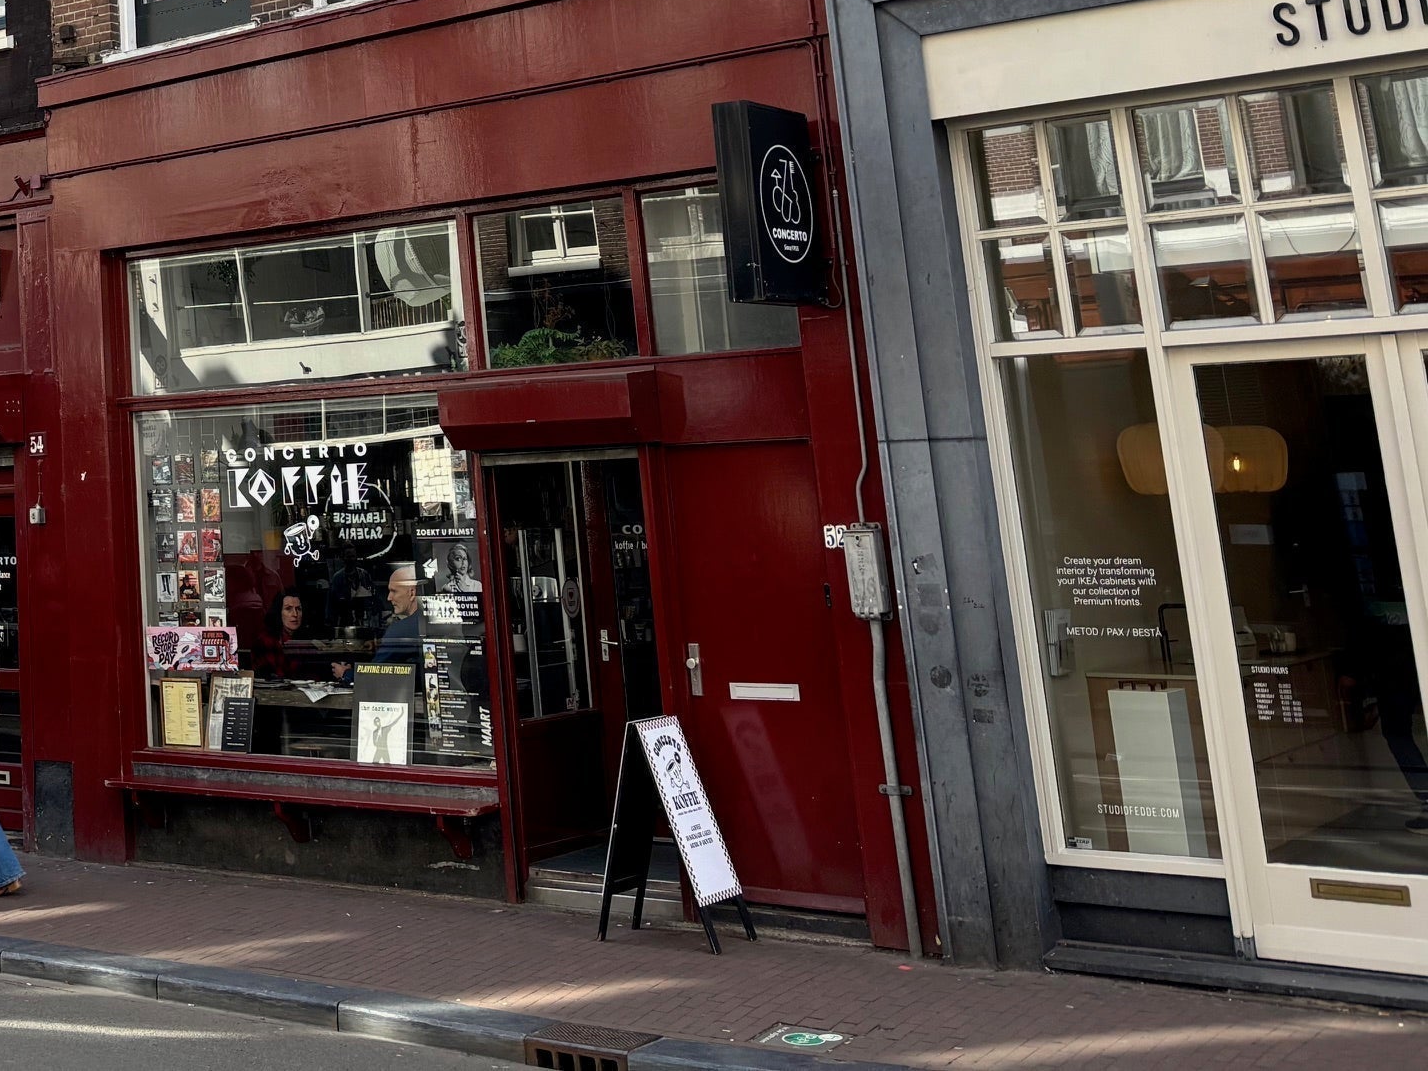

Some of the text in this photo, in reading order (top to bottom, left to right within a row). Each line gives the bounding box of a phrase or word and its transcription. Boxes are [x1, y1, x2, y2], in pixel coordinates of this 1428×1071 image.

[772, 227, 808, 242] CONCERTO
[30, 435, 44, 454] 54
[225, 441, 368, 463] CONCERTO
[226, 463, 368, 508] KOFFIE
[448, 528, 474, 536] FILMS?
[825, 527, 846, 547] 52
[614, 540, 634, 550] koffie
[1063, 556, 1142, 567] Create your dream
[1056, 567, 1155, 577] interior by transforming
[1057, 577, 1157, 586] your IKEA cabinets with
[1088, 587, 1130, 596] collection
[1131, 586, 1141, 596] of
[1073, 597, 1143, 606] Premium fronts.
[1066, 626, 1099, 636] METOD
[1106, 627, 1125, 636] PAX
[152, 631, 180, 648] RECORD
[154, 642, 178, 655] STORE
[158, 652, 176, 665] DAY
[357, 665, 412, 675] PLAYING LIVE TODAY
[1251, 665, 1289, 675] STUDIO HOURS
[479, 706, 492, 746] MAART
[653, 734, 682, 757] CONCERTO
[672, 790, 701, 810] KOFFIE
[1097, 803, 1180, 819] STUDIOFEDDE.COM
